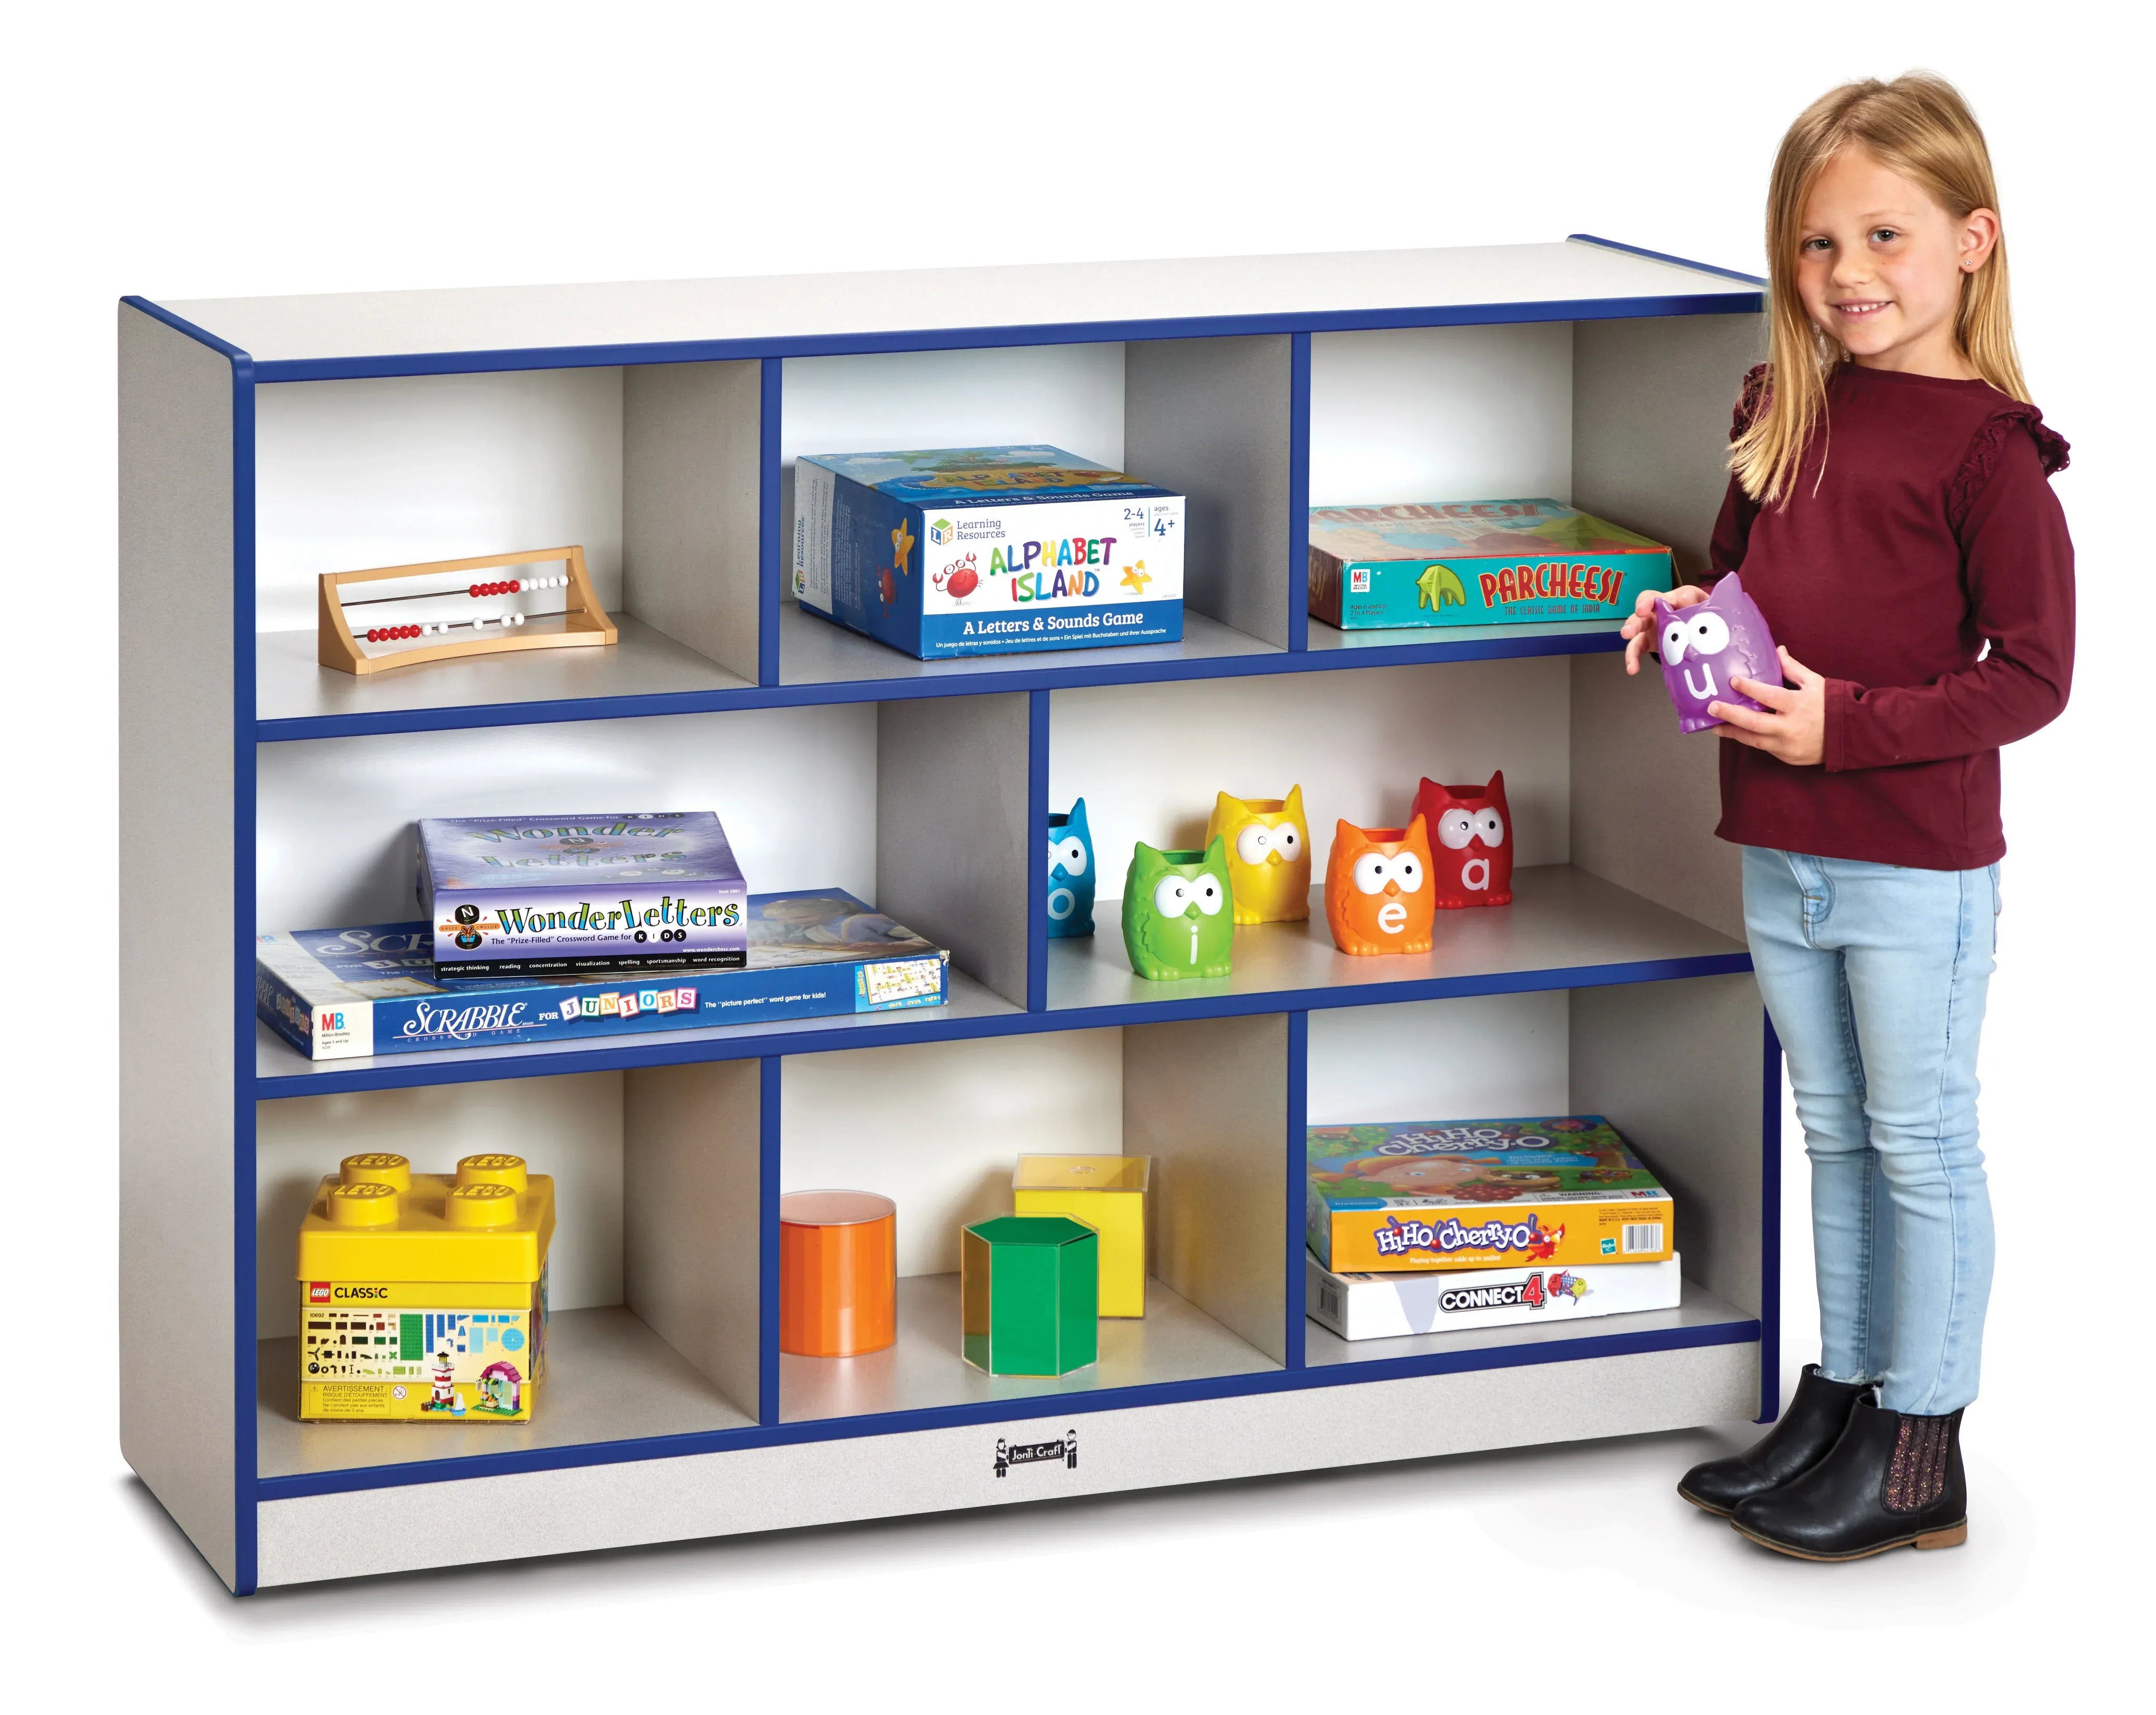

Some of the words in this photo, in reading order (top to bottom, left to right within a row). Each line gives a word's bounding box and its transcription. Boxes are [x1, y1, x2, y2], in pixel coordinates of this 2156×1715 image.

[1124, 508, 1144, 520] 2-4
[957, 518, 1001, 530] Learning
[1154, 518, 1175, 536] 4+
[957, 530, 1005, 540] Resources
[990, 537, 1117, 576] ALPHABET
[1011, 569, 1100, 602] ISLAND
[1354, 571, 1369, 583] MB
[1478, 563, 1624, 608] PARCHEESI
[1504, 606, 1516, 615] THE
[1520, 606, 1544, 615] CLASSIC
[1548, 605, 1567, 614] GAME
[1570, 605, 1578, 614] OF
[1582, 604, 1600, 613] INDIA
[963, 621, 975, 635] A
[977, 620, 1030, 635] Letters
[1033, 617, 1044, 631] &
[1047, 613, 1100, 630] Sounds
[1103, 613, 1143, 626] Game
[1684, 663, 1718, 700] u
[469, 821, 685, 843] Wonder
[477, 851, 687, 868] Letters
[1461, 859, 1490, 890] a
[461, 906, 474, 919] N
[1048, 888, 1075, 920] o
[495, 896, 740, 935] WonderLetters
[1378, 902, 1407, 934] e
[556, 934, 595, 942] Crossword
[1190, 925, 1198, 965] i
[322, 1012, 345, 1031] MB
[403, 1002, 526, 1040] SCRABBLE
[538, 1012, 559, 1021] FOR
[564, 991, 693, 1017] JUNIORS
[407, 1032, 477, 1042] CROSSWORD
[347, 1156, 403, 1165] LEGO
[464, 1156, 520, 1166] LEGO
[334, 1185, 392, 1195] LEGO
[453, 1186, 510, 1196] LEGO
[311, 1288, 330, 1297] LEGO
[1441, 1286, 1524, 1310] CONNECT
[1522, 1275, 1543, 1307] 4
